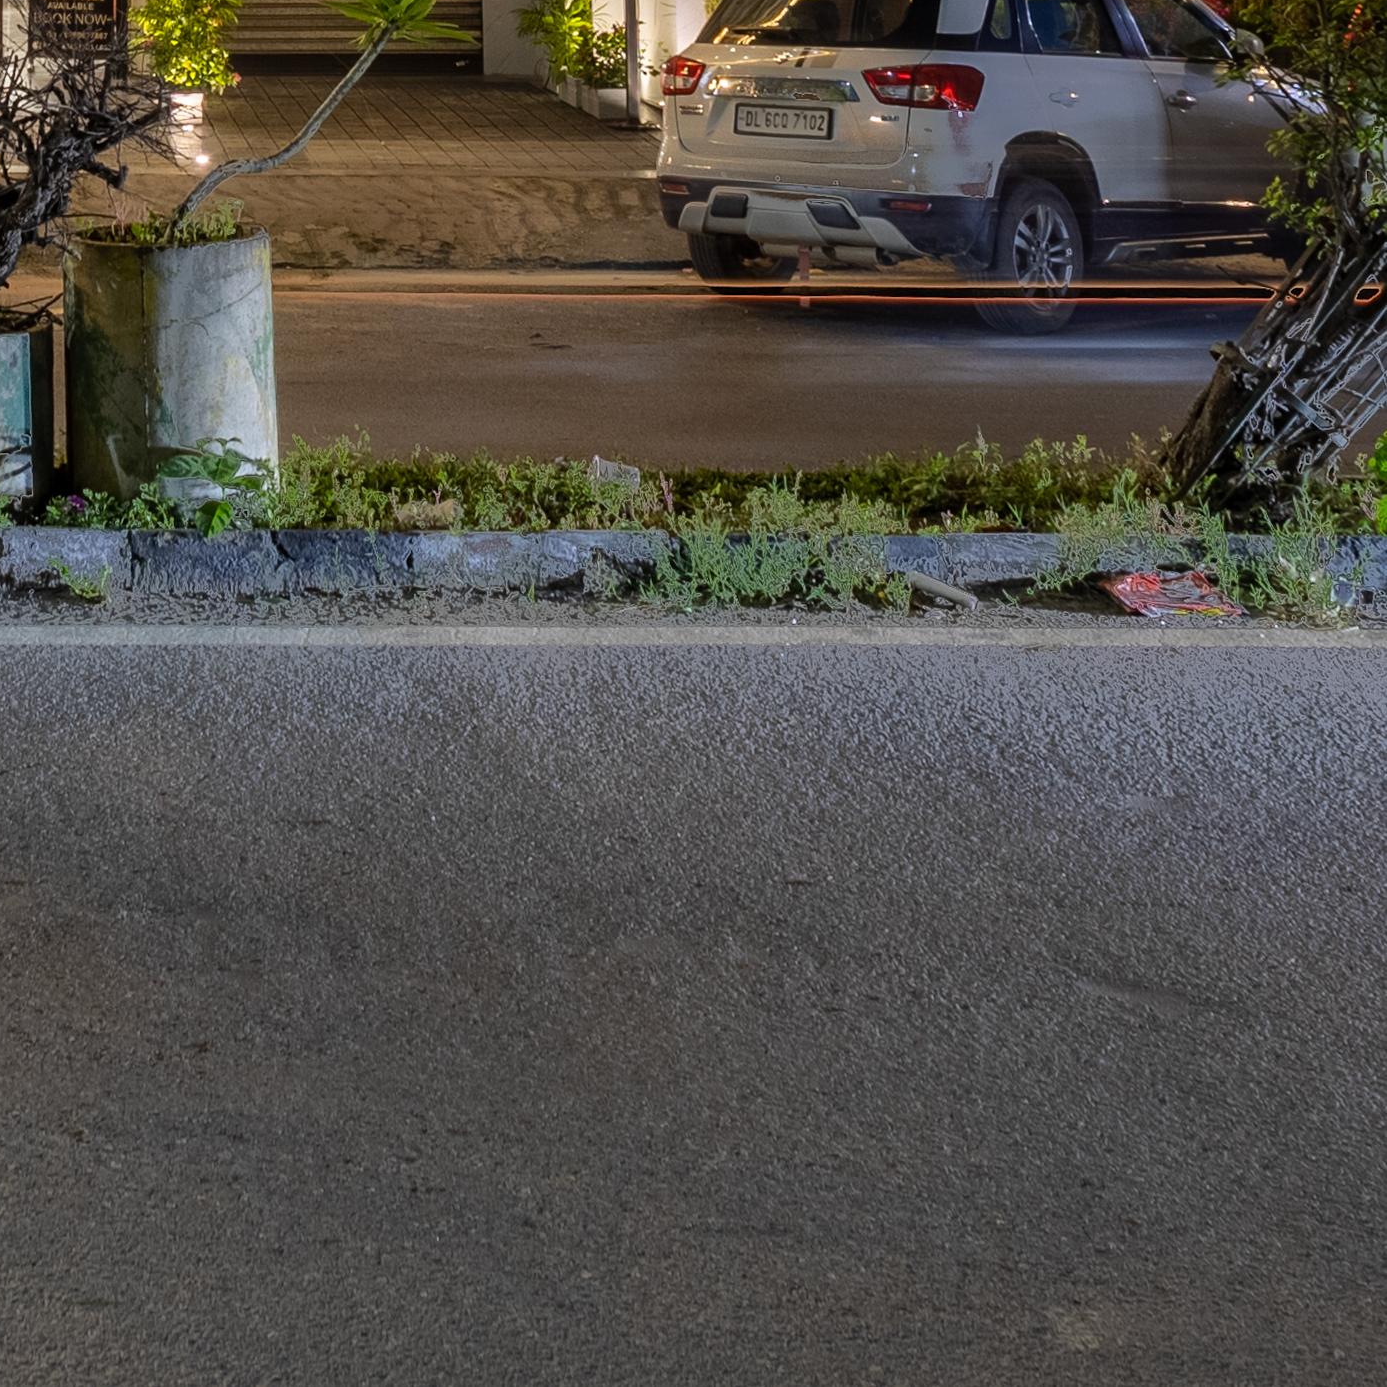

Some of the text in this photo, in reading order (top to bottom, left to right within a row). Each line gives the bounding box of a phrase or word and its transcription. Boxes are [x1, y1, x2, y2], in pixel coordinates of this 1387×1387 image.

[47, 1, 94, 11] AVAILABLE
[745, 110, 761, 128] DL
[793, 113, 825, 131] 7102
